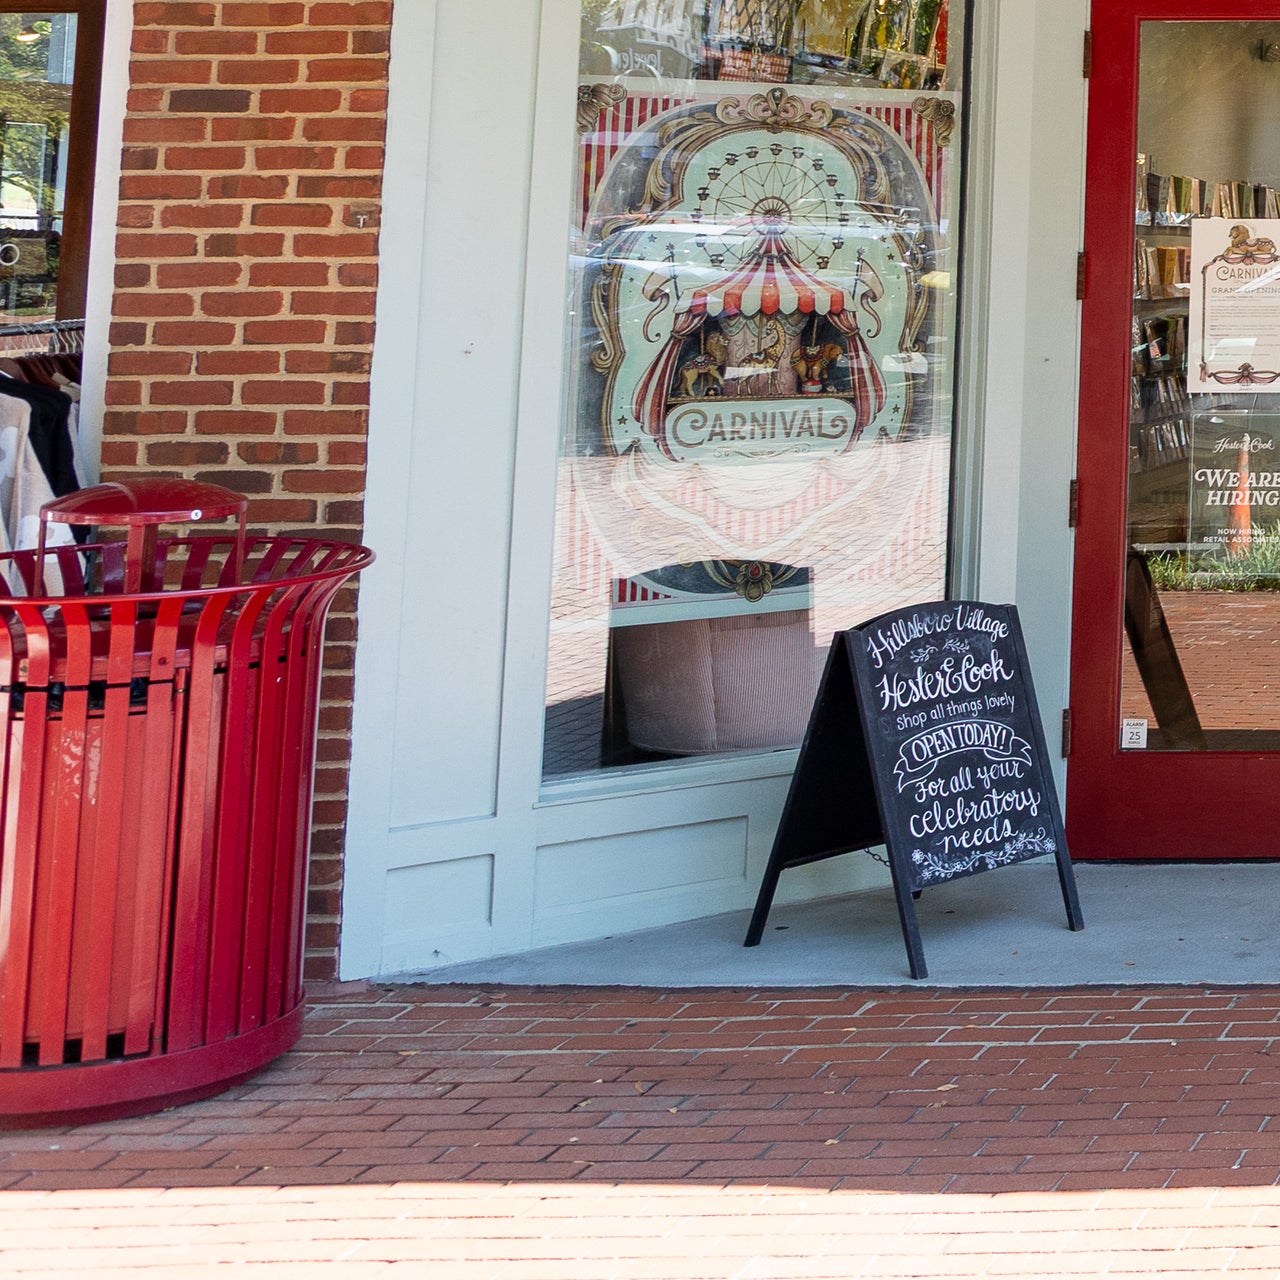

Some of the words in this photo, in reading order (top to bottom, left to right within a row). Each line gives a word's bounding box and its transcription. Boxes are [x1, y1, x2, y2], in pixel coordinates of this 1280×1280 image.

[672, 407, 849, 448] CARNIVAL
[1194, 469, 1241, 488] WE
[866, 613, 954, 669] Hillsboro
[953, 604, 1009, 642] Village
[930, 703, 945, 720] all
[946, 698, 983, 717] things
[984, 691, 1015, 713] lovely
[1129, 731, 1141, 740] 25
[914, 777, 949, 803] For
[950, 766, 975, 794] all
[976, 760, 1024, 790] your
[909, 787, 1041, 838] celebratory
[936, 817, 1019, 854] needs
